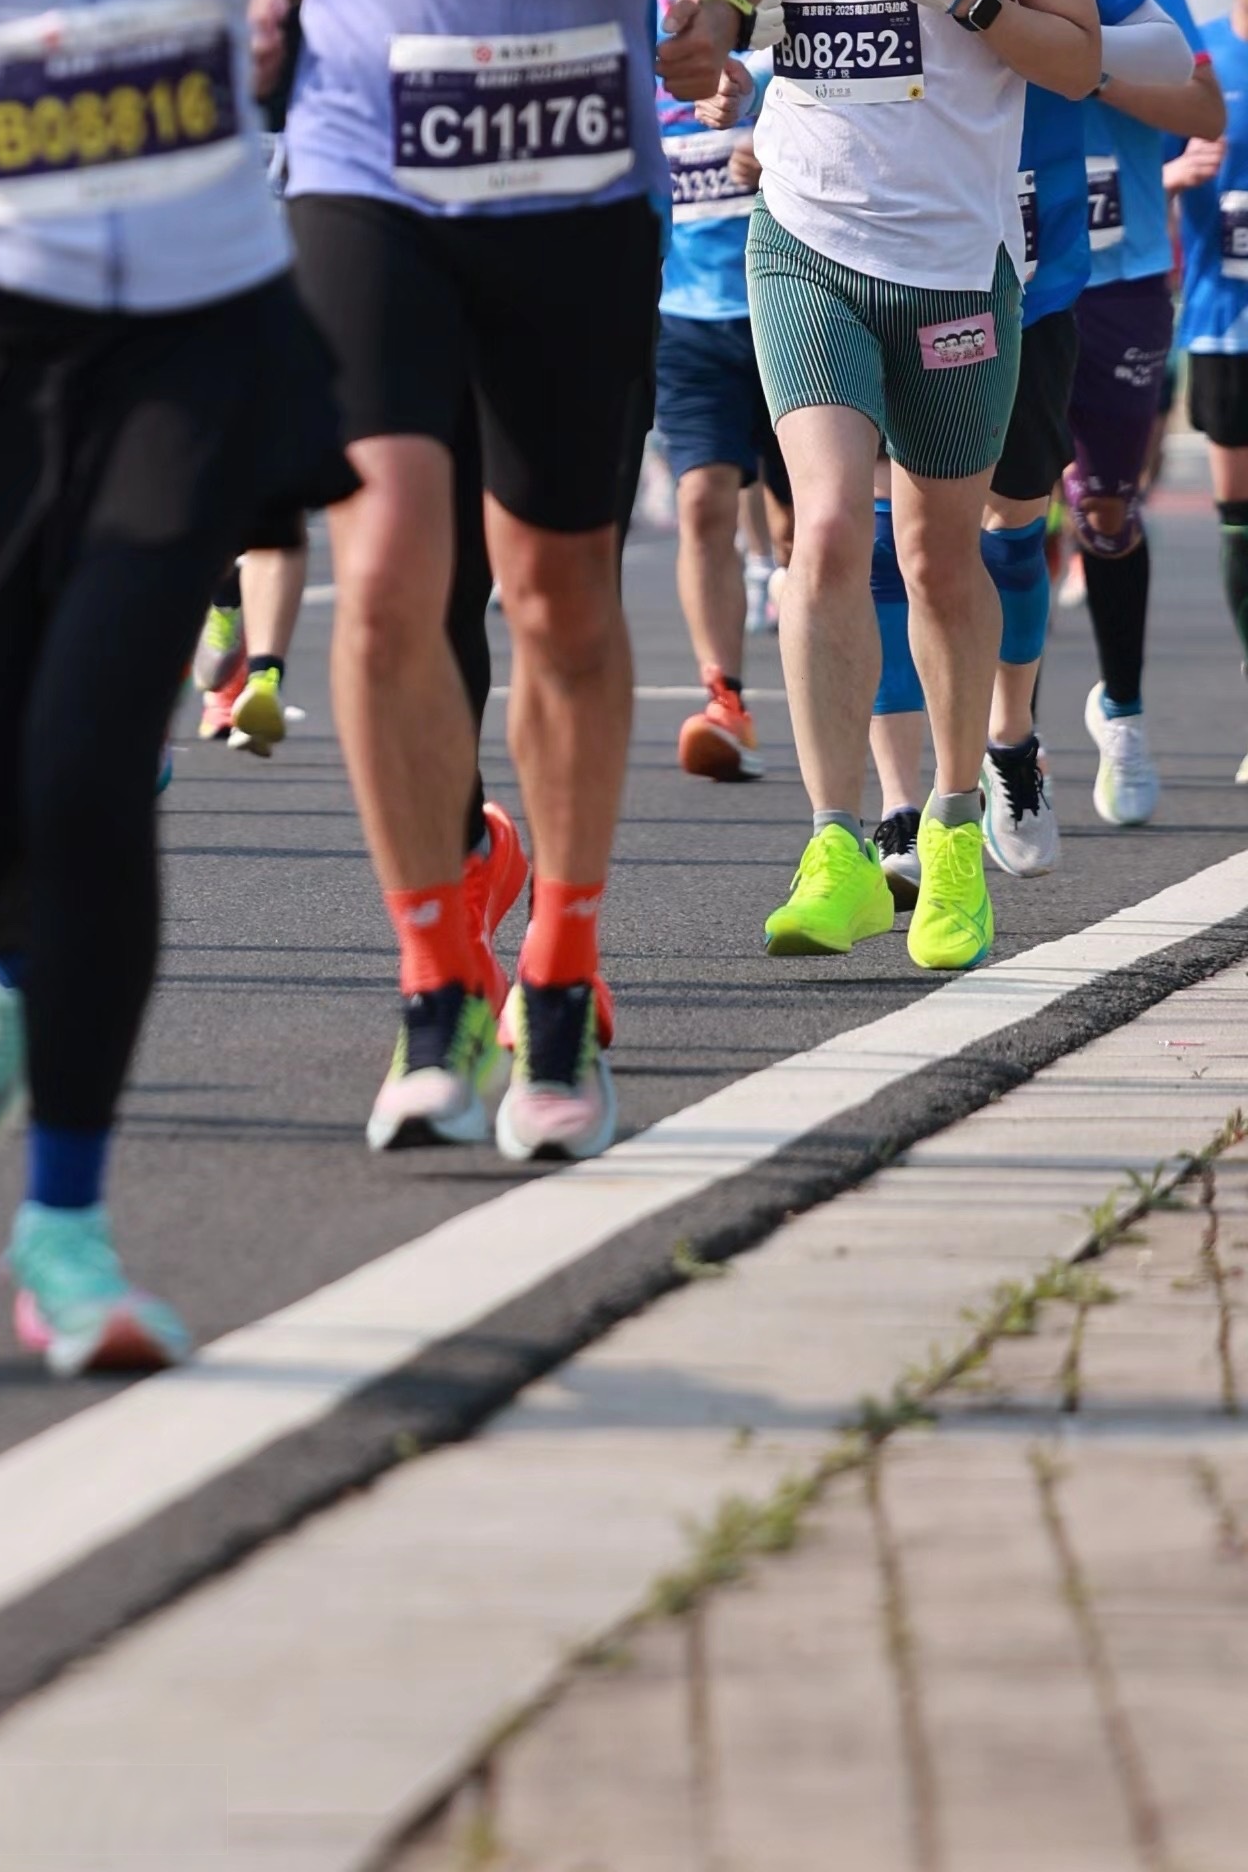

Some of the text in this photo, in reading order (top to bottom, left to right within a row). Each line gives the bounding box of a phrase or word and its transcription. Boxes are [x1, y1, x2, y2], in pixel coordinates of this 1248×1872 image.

[781, 30, 901, 69] B08252
[420, 94, 608, 158] C11176
[670, 165, 749, 203] C1332
